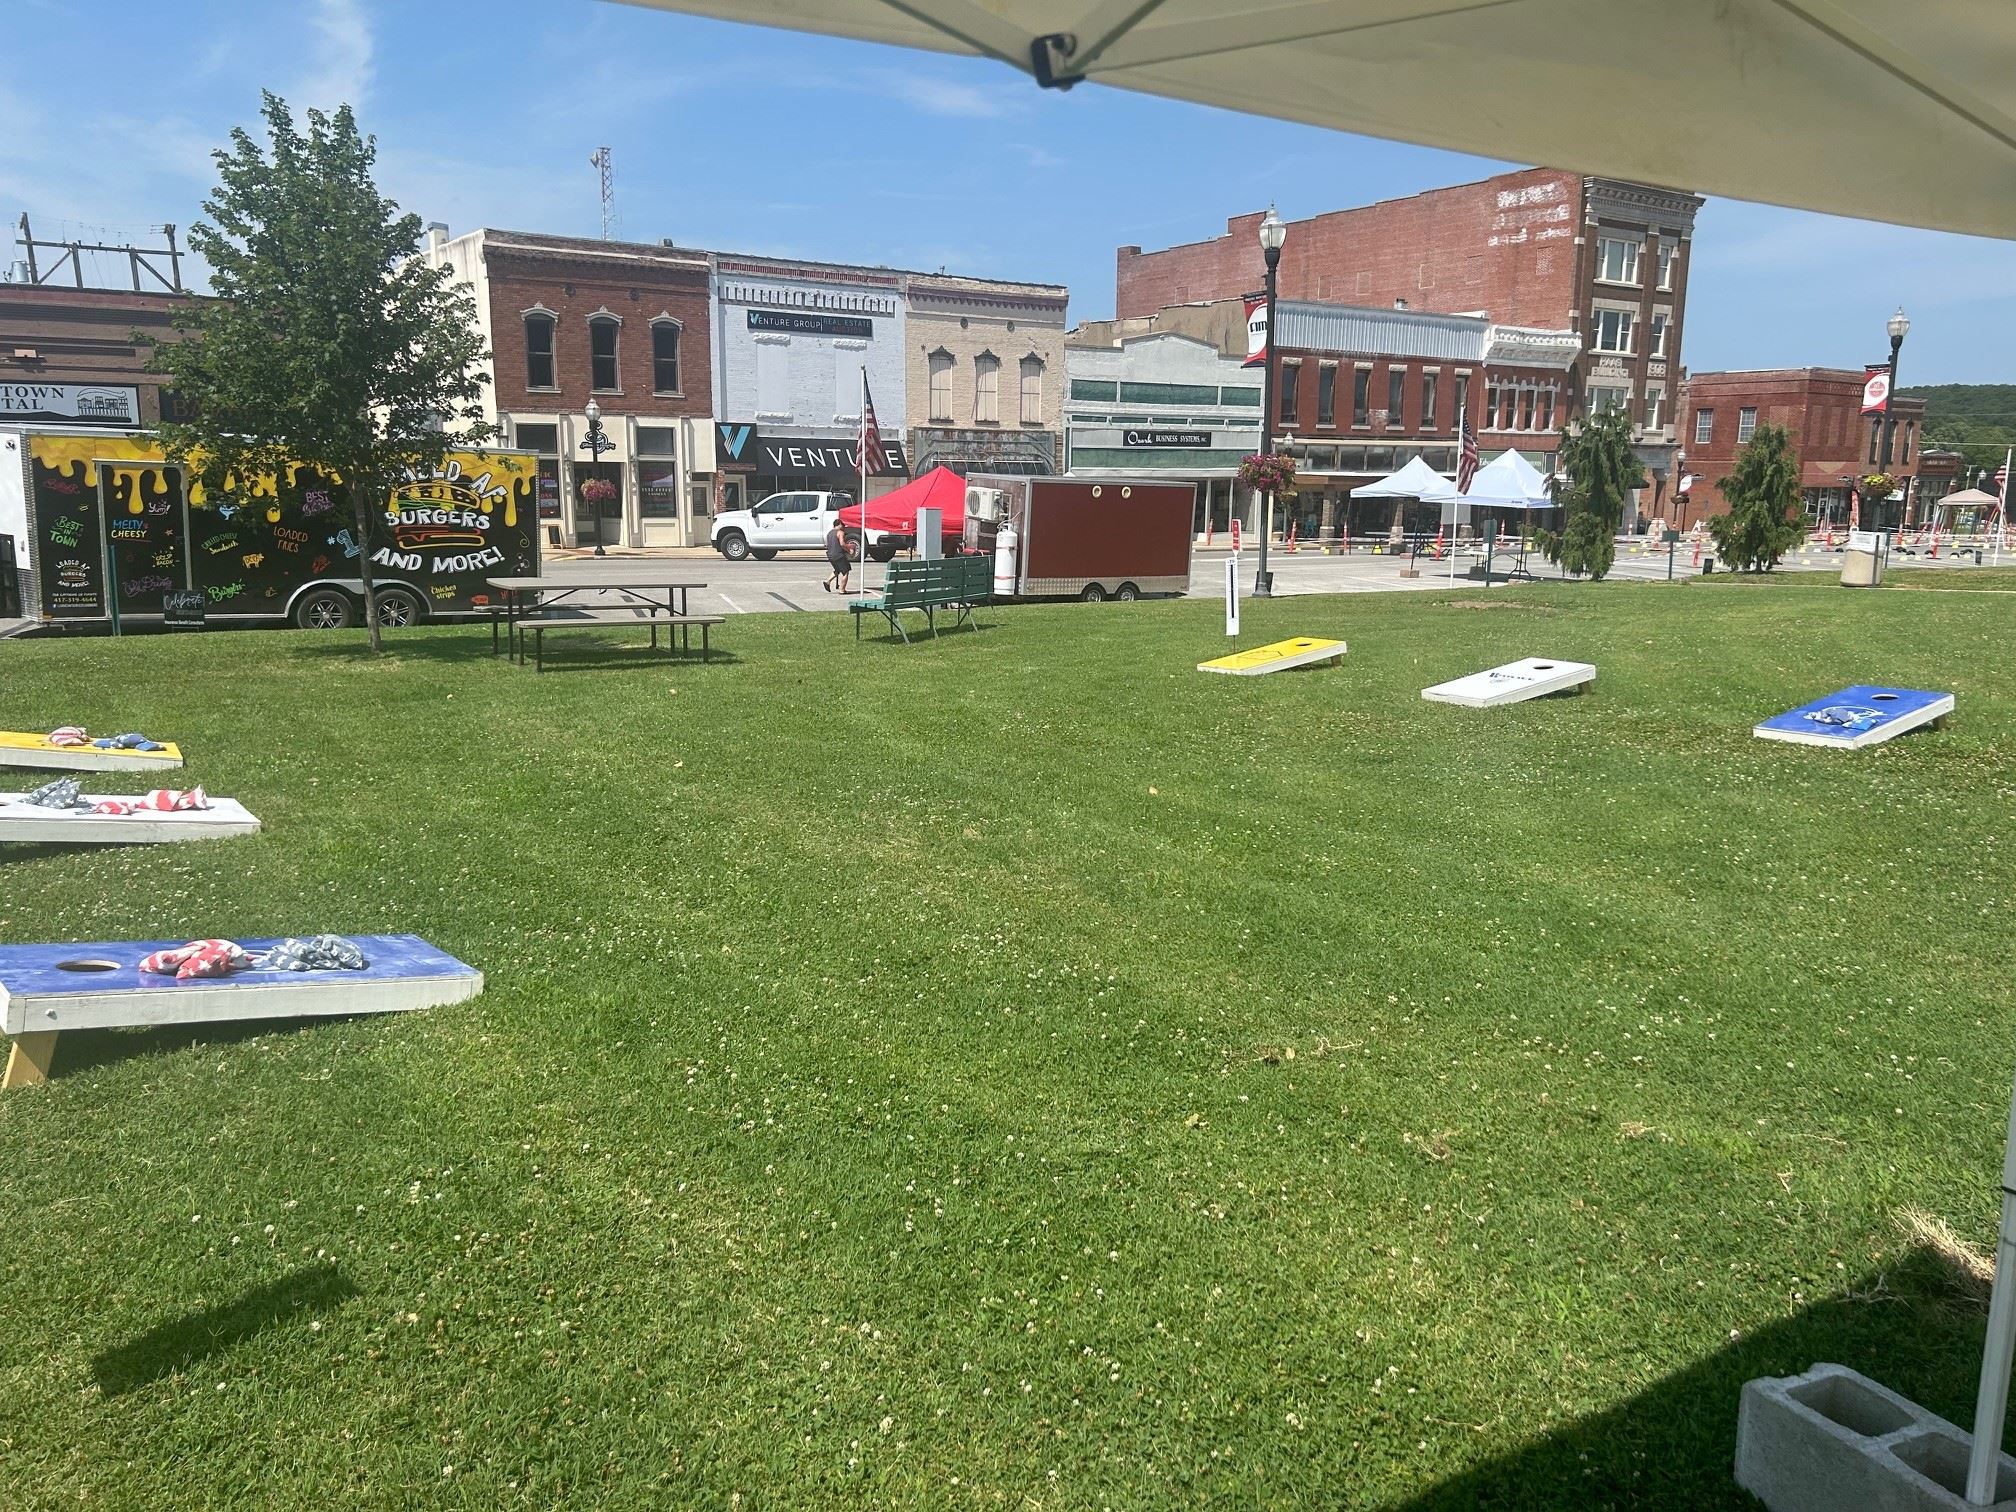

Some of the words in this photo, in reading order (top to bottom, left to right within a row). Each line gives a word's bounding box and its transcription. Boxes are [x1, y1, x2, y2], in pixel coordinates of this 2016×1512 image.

[749, 313, 790, 327] VENTURE
[793, 320, 821, 329] GROUP
[823, 318, 841, 326] REAL
[845, 320, 871, 328] ESTATE
[0, 386, 64, 399] TOWN
[0, 398, 44, 410] TAL
[1156, 435, 1178, 443] BUSINESS
[766, 446, 903, 470] VENTUE
[470, 472, 509, 499] AF
[113, 519, 143, 530] MELTY
[385, 509, 490, 530] BURGERS
[50, 530, 78, 548] TOWN
[111, 530, 147, 538] CHEESY
[273, 526, 308, 543] LOADED
[278, 539, 299, 553] FRIES
[369, 547, 422, 571] AND
[432, 545, 506, 574] MORE!
